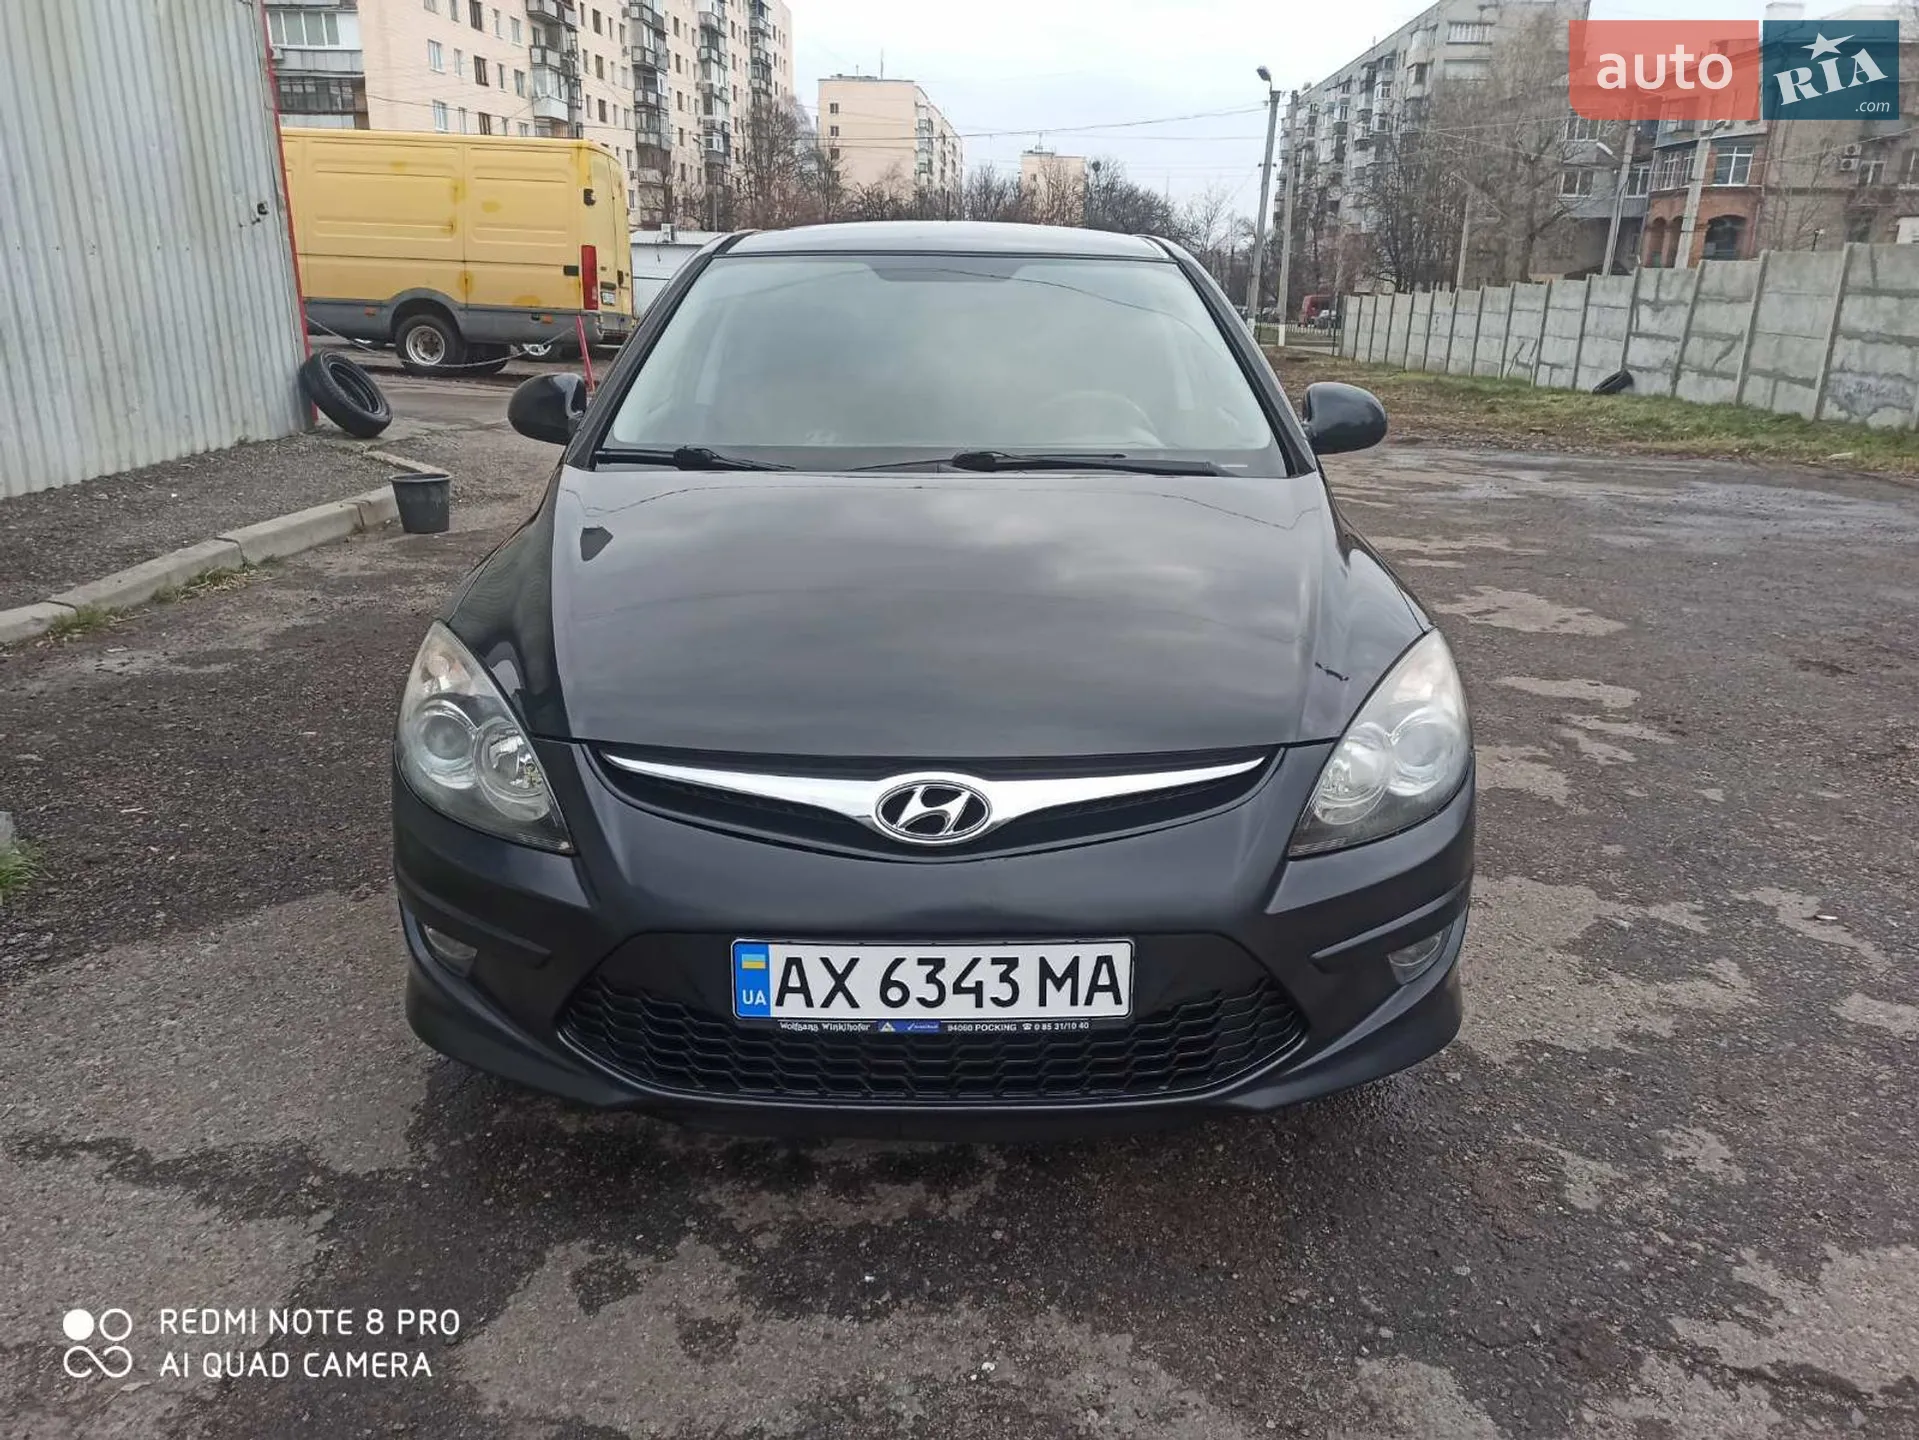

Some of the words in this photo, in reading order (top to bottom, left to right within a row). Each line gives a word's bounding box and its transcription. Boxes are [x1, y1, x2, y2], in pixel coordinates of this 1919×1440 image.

[775, 956, 861, 1009] AX
[879, 956, 1020, 1009] 6343
[1038, 955, 1123, 1008] MA
[742, 989, 767, 1006] UA
[974, 1023, 1017, 1032] POCKING
